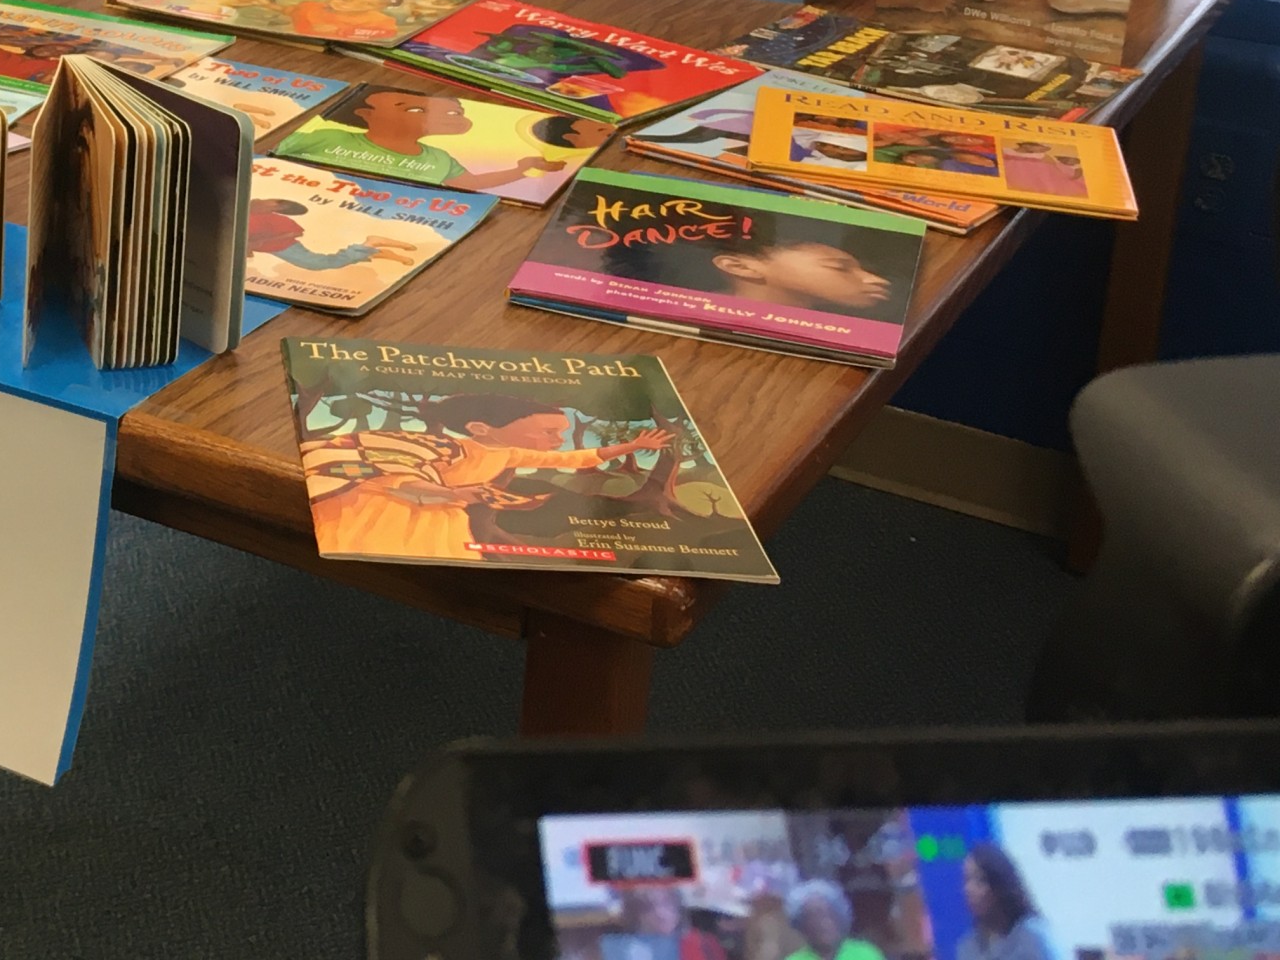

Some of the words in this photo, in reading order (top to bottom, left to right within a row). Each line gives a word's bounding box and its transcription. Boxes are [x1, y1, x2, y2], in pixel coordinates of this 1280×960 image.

[990, 10, 1032, 27] Williams
[514, 7, 599, 40] Worry
[603, 32, 678, 59] Wart
[680, 52, 741, 76] Wes
[187, 72, 209, 81] by
[205, 61, 261, 79] Two
[262, 75, 287, 85] of
[290, 77, 327, 92] Us
[784, 93, 889, 115] READ
[903, 109, 987, 126] AND
[1003, 119, 1094, 139] RISE
[323, 144, 397, 166] Jordan's
[397, 158, 436, 172] Hair
[251, 163, 280, 178] st
[280, 172, 322, 189] the
[326, 179, 392, 201] Two
[394, 196, 427, 210] of
[427, 197, 473, 217] Us
[308, 193, 331, 206] by
[588, 194, 734, 229] HAIR
[901, 192, 972, 213] World
[565, 216, 753, 250] DANCE!
[245, 276, 286, 290] ADiR
[288, 283, 357, 302] NELSON
[553, 271, 588, 282] words
[590, 277, 605, 286] by
[605, 288, 680, 307] photographs
[681, 300, 697, 310] by
[702, 303, 756, 318] KELLY
[761, 313, 852, 335] JOHNSON
[300, 341, 368, 361] The
[376, 345, 557, 375] Patchwork
[561, 357, 643, 378] Path
[375, 365, 426, 376] QUILT
[431, 369, 466, 379] MAP
[471, 372, 495, 381] TO
[499, 375, 583, 386] FREEDOM
[568, 515, 617, 529] Bettye
[619, 518, 672, 531] Stroud
[573, 530, 622, 541] illustrated
[622, 533, 637, 543] by
[576, 538, 612, 550] Erin
[614, 540, 676, 554] Susanne
[678, 543, 740, 558] Bennett
[485, 544, 614, 560] SCHOLASTIC
